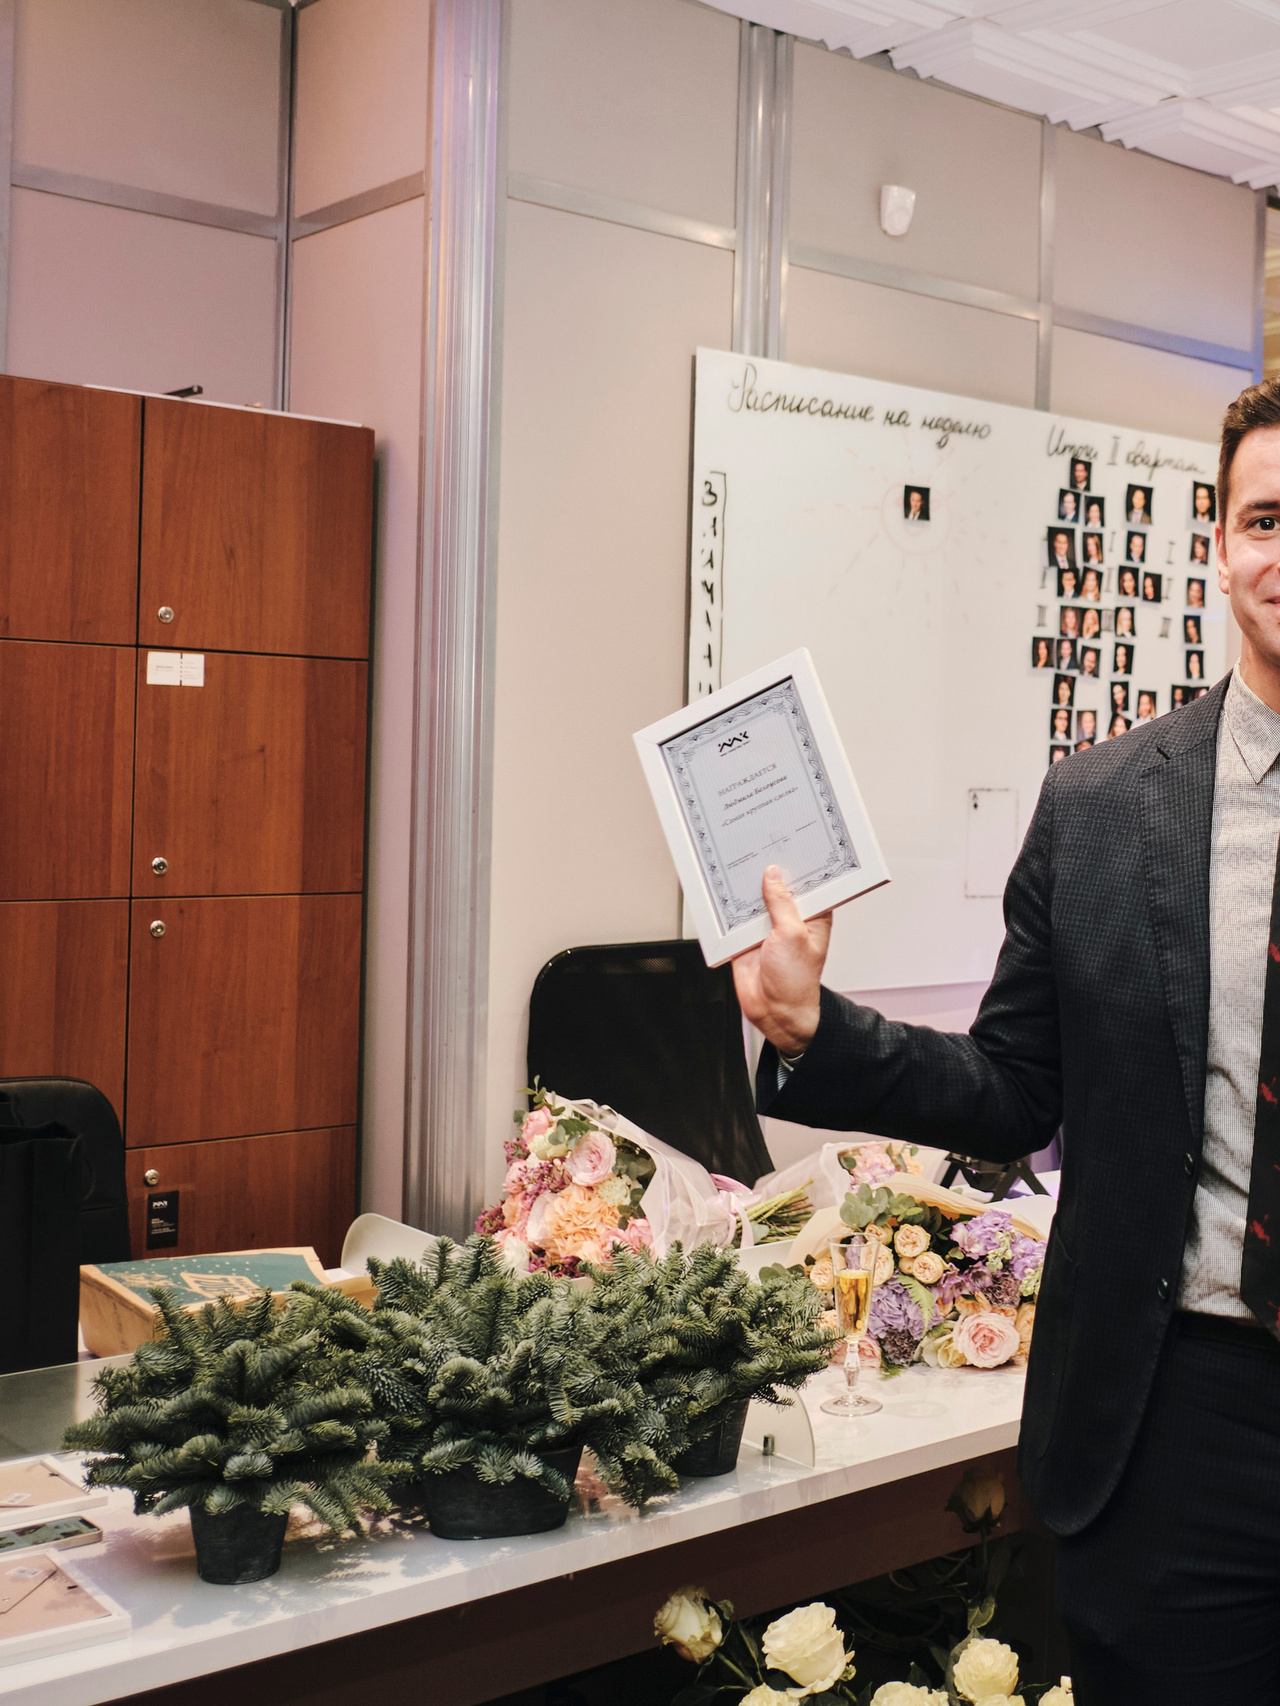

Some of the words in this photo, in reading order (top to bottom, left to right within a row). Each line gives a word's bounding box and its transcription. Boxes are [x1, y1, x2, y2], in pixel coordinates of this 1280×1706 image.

[728, 362, 874, 422] Расписание
[882, 408, 911, 428] на
[920, 415, 993, 450] неделю
